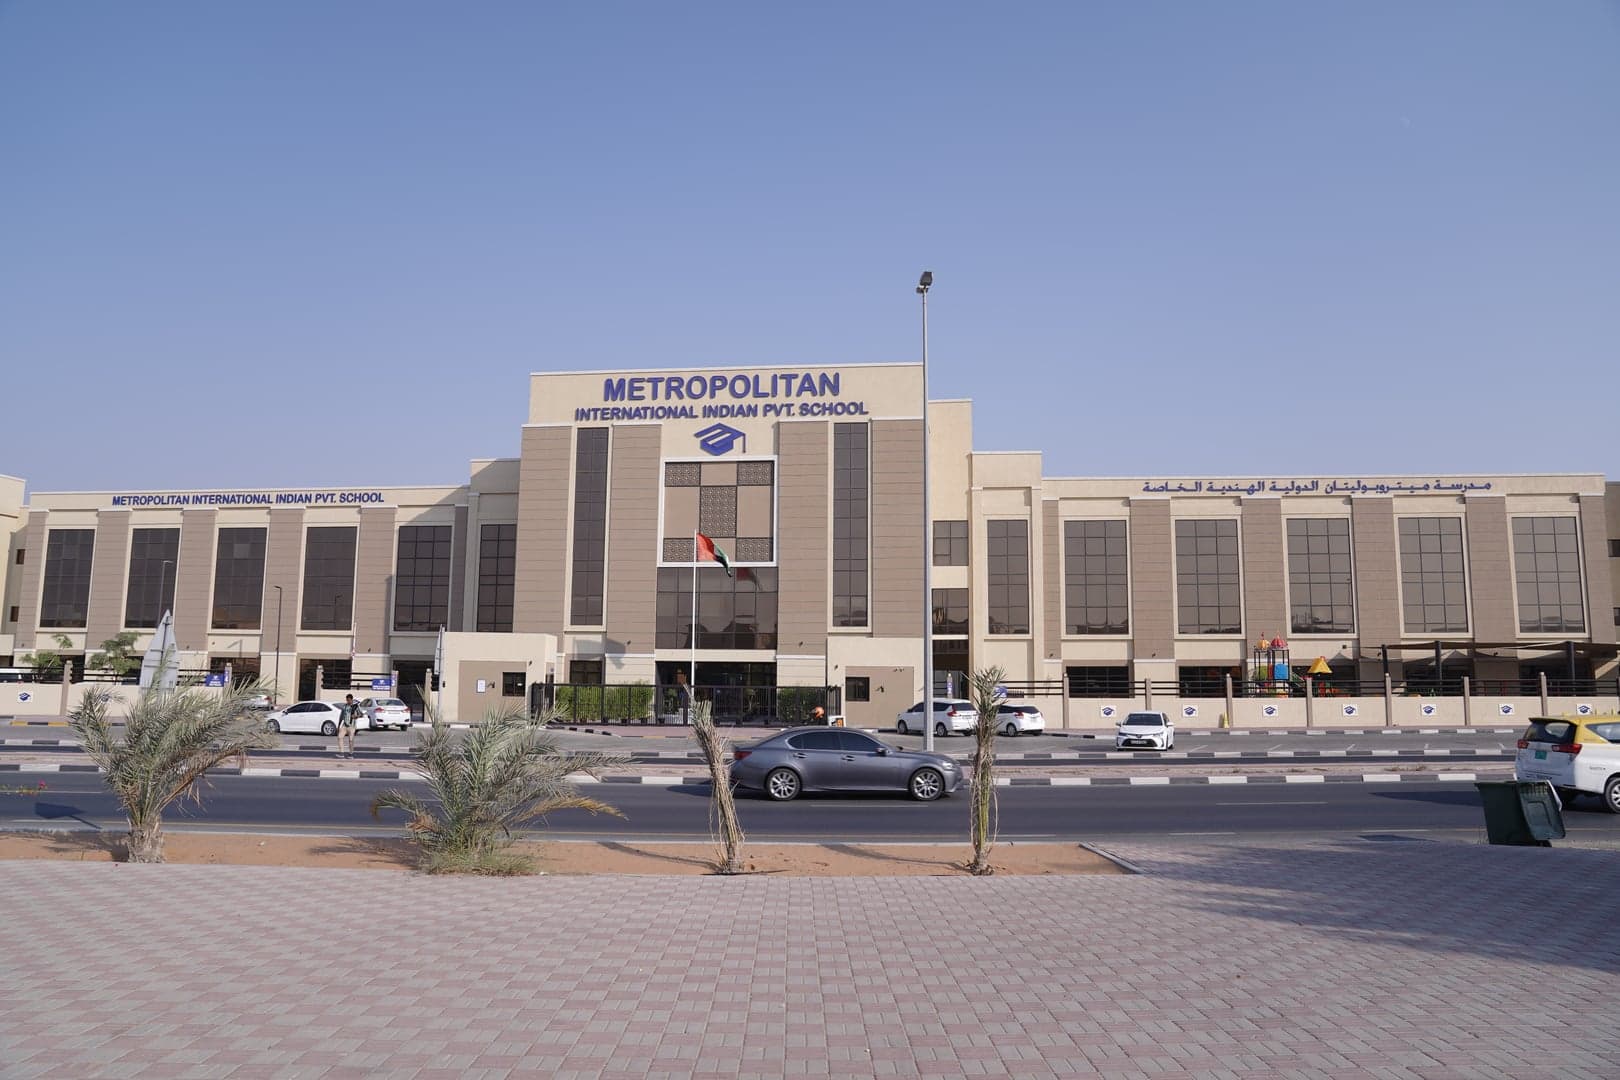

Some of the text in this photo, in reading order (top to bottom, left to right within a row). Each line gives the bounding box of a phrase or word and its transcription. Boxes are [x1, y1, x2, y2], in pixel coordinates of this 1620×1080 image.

[603, 372, 841, 402] METROPOLITAN
[575, 401, 869, 421] INTERNATIONAL INDIAN PVT. SCHOOL
[1142, 481, 1202, 493] الخاصة
[1206, 480, 1265, 495] الهندية
[1269, 480, 1319, 495] الدولية
[1433, 480, 1492, 493] مدرسة
[112, 492, 384, 506] METROPOLITAN INTERNATIONAL INDIAN PVT. SCHOOL
